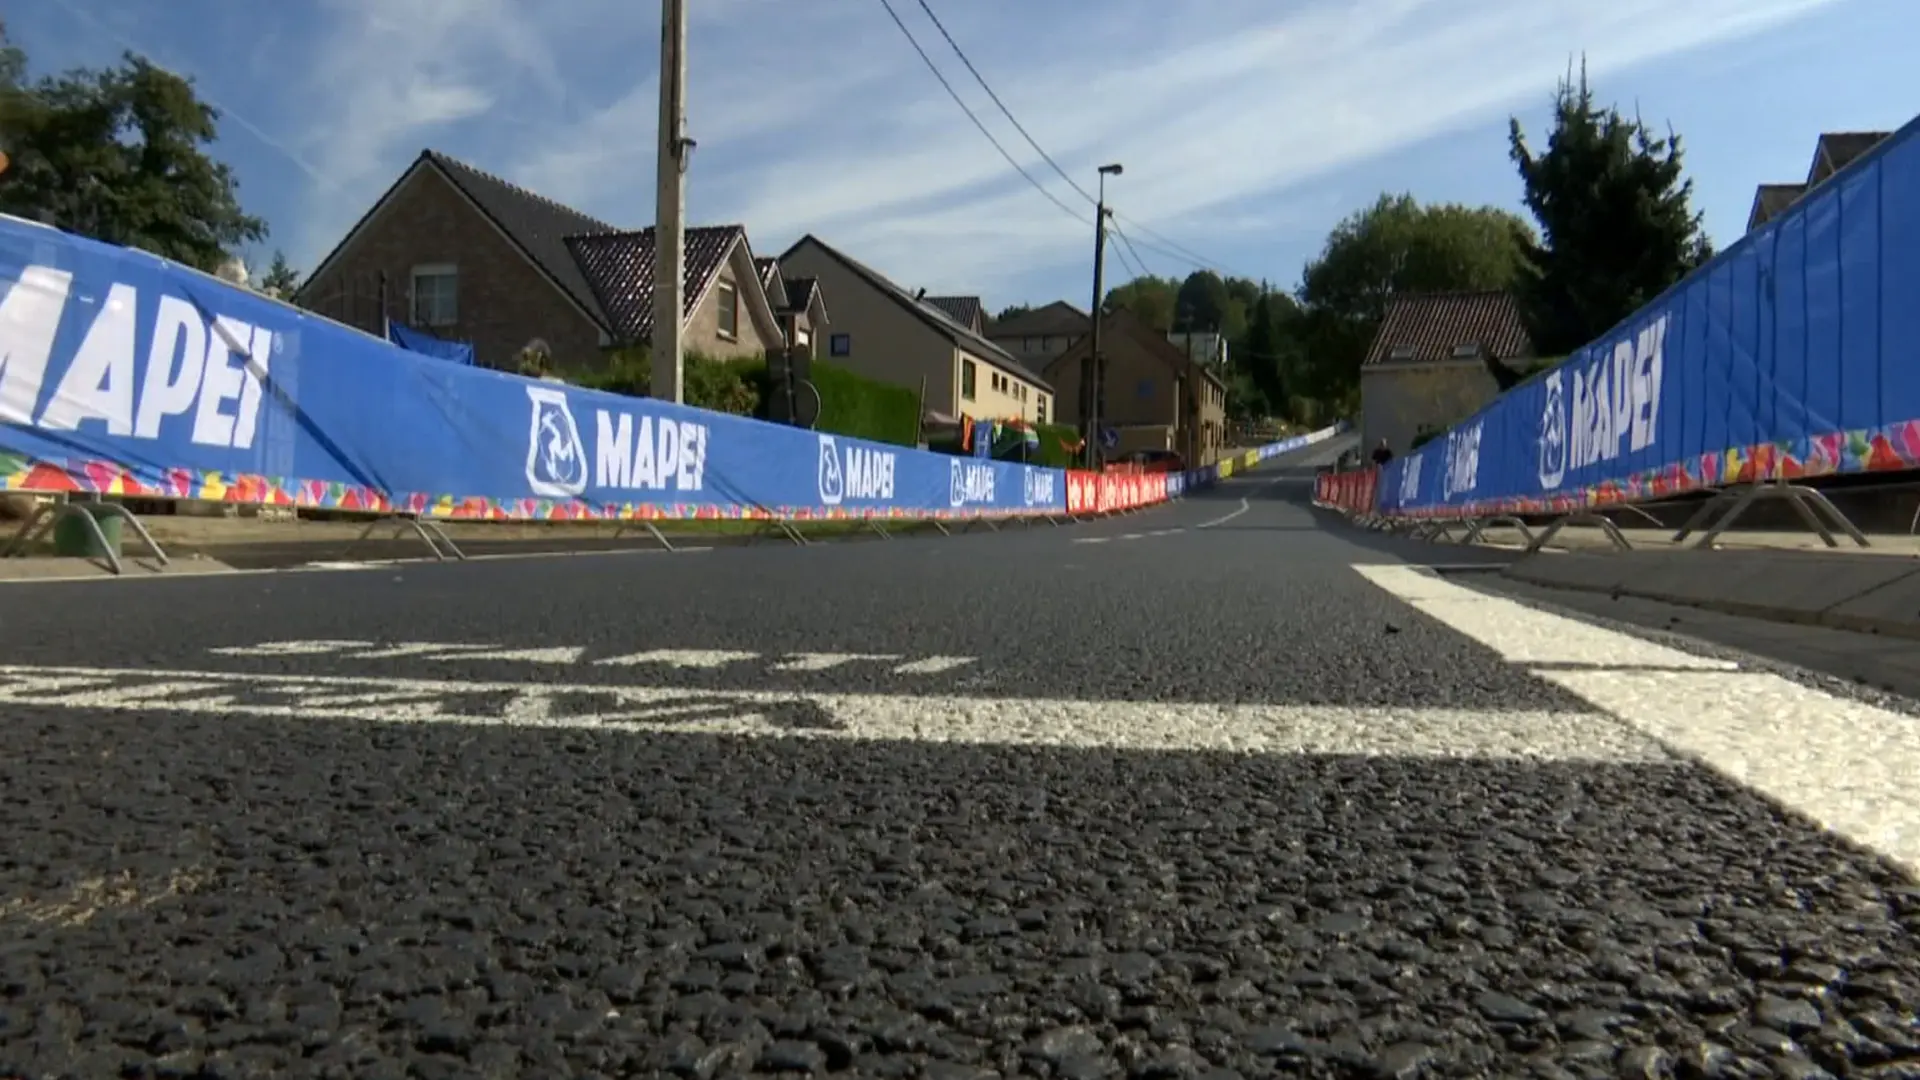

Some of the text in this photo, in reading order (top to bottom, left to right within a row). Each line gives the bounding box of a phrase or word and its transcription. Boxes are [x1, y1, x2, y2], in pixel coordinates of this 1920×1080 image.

[1570, 314, 1666, 470] MAPEI
[596, 409, 707, 490] MAPEI
[846, 447, 895, 498] MAPEI
